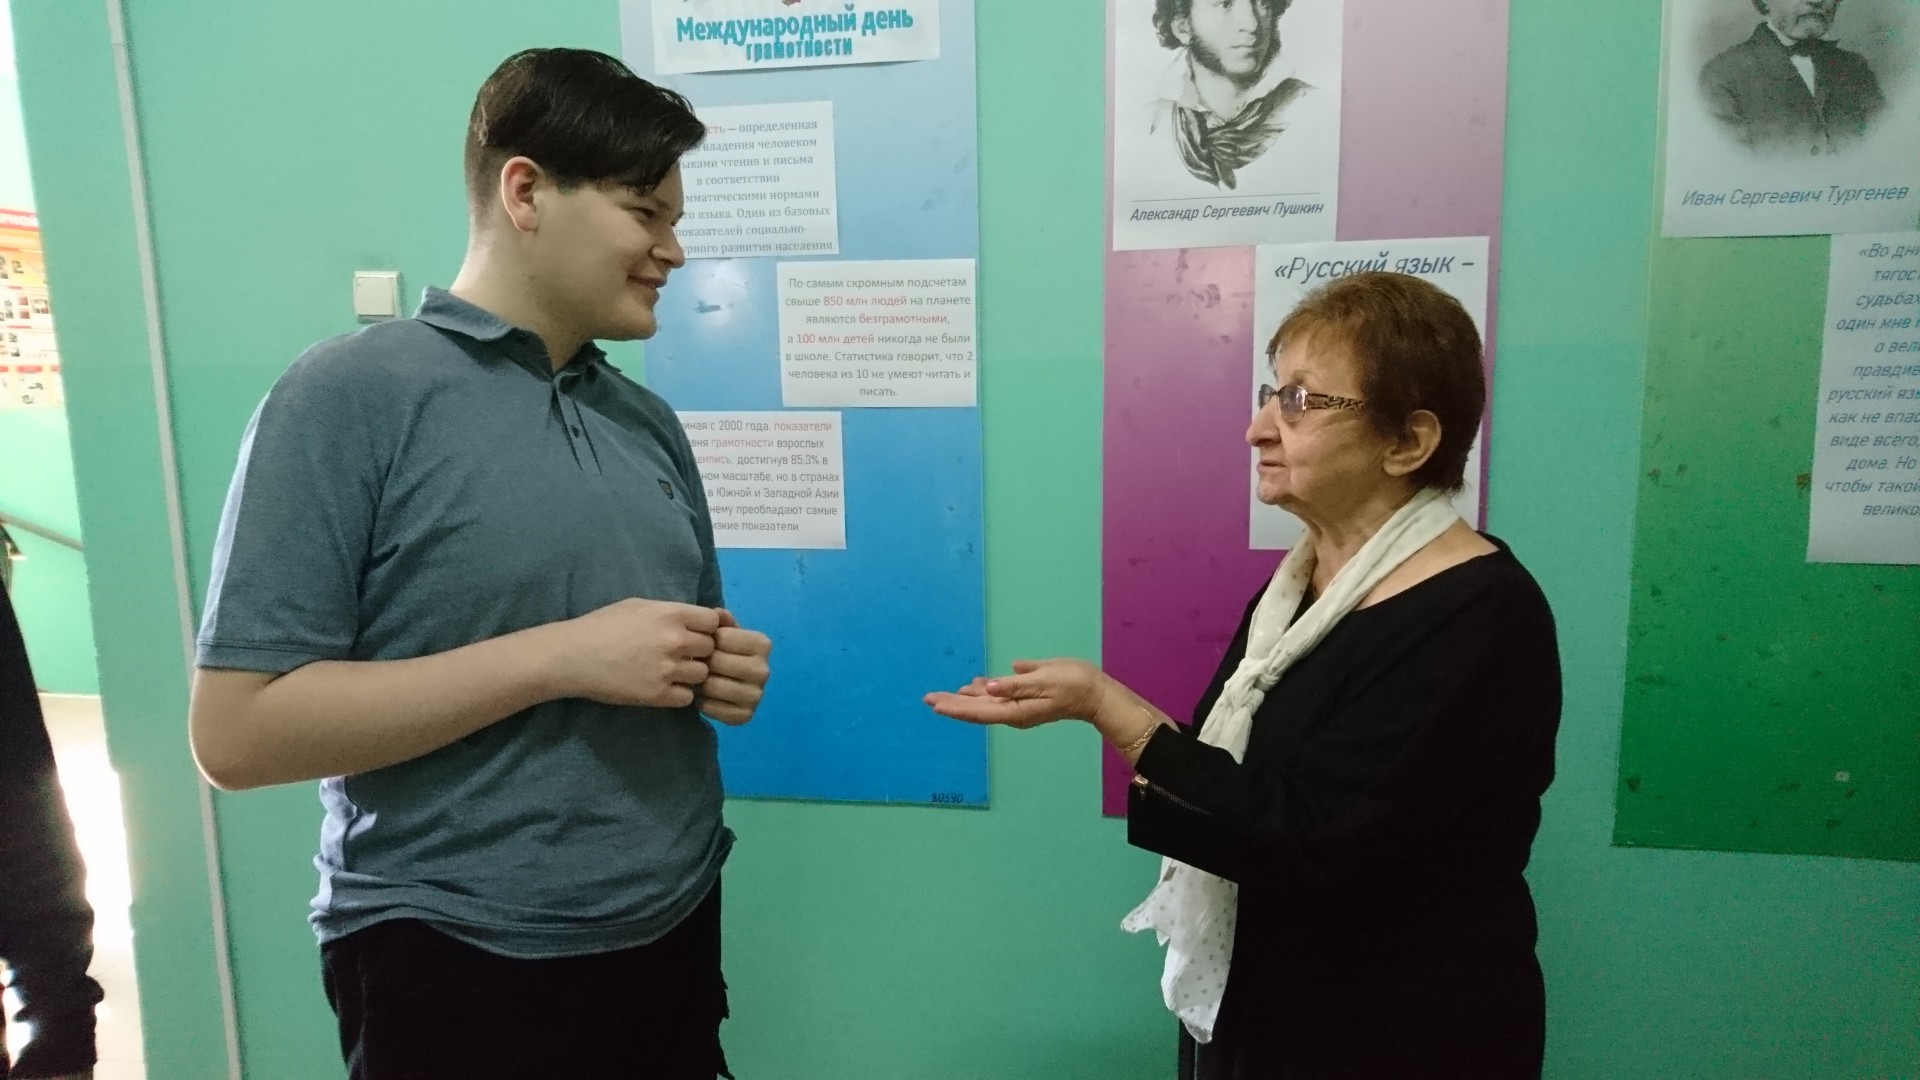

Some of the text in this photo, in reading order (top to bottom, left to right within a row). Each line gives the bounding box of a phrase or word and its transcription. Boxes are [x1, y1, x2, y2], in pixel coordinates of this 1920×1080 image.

[676, 3, 914, 46] Международный день
[746, 37, 853, 62] грамотности
[739, 120, 818, 135] определенная
[703, 140, 755, 152] владения
[757, 138, 817, 149] человеком
[682, 155, 814, 169] ыками чтения и письма
[696, 174, 780, 186] в соответствии
[685, 190, 820, 203] мматическими нормами
[1682, 185, 1910, 208] Иван Сергеевич Тургенев
[736, 207, 766, 219] Один
[768, 209, 782, 217] из
[784, 206, 831, 216] базовых
[1130, 202, 1324, 222] Александр Сергеевич Пушкин
[745, 224, 807, 236] социально-
[721, 243, 772, 255] развития
[1859, 243, 1889, 258] «Во
[1274, 251, 1390, 285] «Русский
[1395, 256, 1456, 274] язык
[1874, 269, 1920, 281] тягос
[788, 277, 967, 290] По самым скромным подсчетам
[785, 295, 971, 307] свыше 850 млн людей на планете
[806, 315, 856, 325] являются
[1836, 318, 1876, 332] один
[1880, 317, 1912, 329] мне
[787, 333, 971, 346] а 100 млн детей никогда не были
[1874, 341, 1920, 353] о вел
[785, 351, 973, 363] в школе. Статистика говорит, что 2
[788, 369, 971, 381] человека из 10 не умеют читать и
[1853, 365, 1920, 380] правдив
[1825, 385, 1895, 404] русский
[1829, 412, 1920, 424] как не впас
[682, 422, 708, 431] иная
[710, 422, 716, 431] с
[719, 420, 743, 431] 2000
[774, 422, 832, 432] показатели
[690, 440, 825, 450] вня грамотности взрослых
[1830, 435, 1870, 448] виде
[737, 455, 788, 467] достигнув
[822, 457, 829, 465] в
[1896, 455, 1917, 470] Но
[776, 473, 789, 482] но
[791, 474, 798, 482] в
[800, 473, 840, 483] странах
[1825, 478, 1873, 493] чтобы
[707, 487, 840, 500] в Южной и Западной Азии
[736, 504, 803, 516] преобладают
[805, 507, 838, 516] самые
[1862, 504, 1920, 516] велико
[712, 522, 739, 531] изкие
